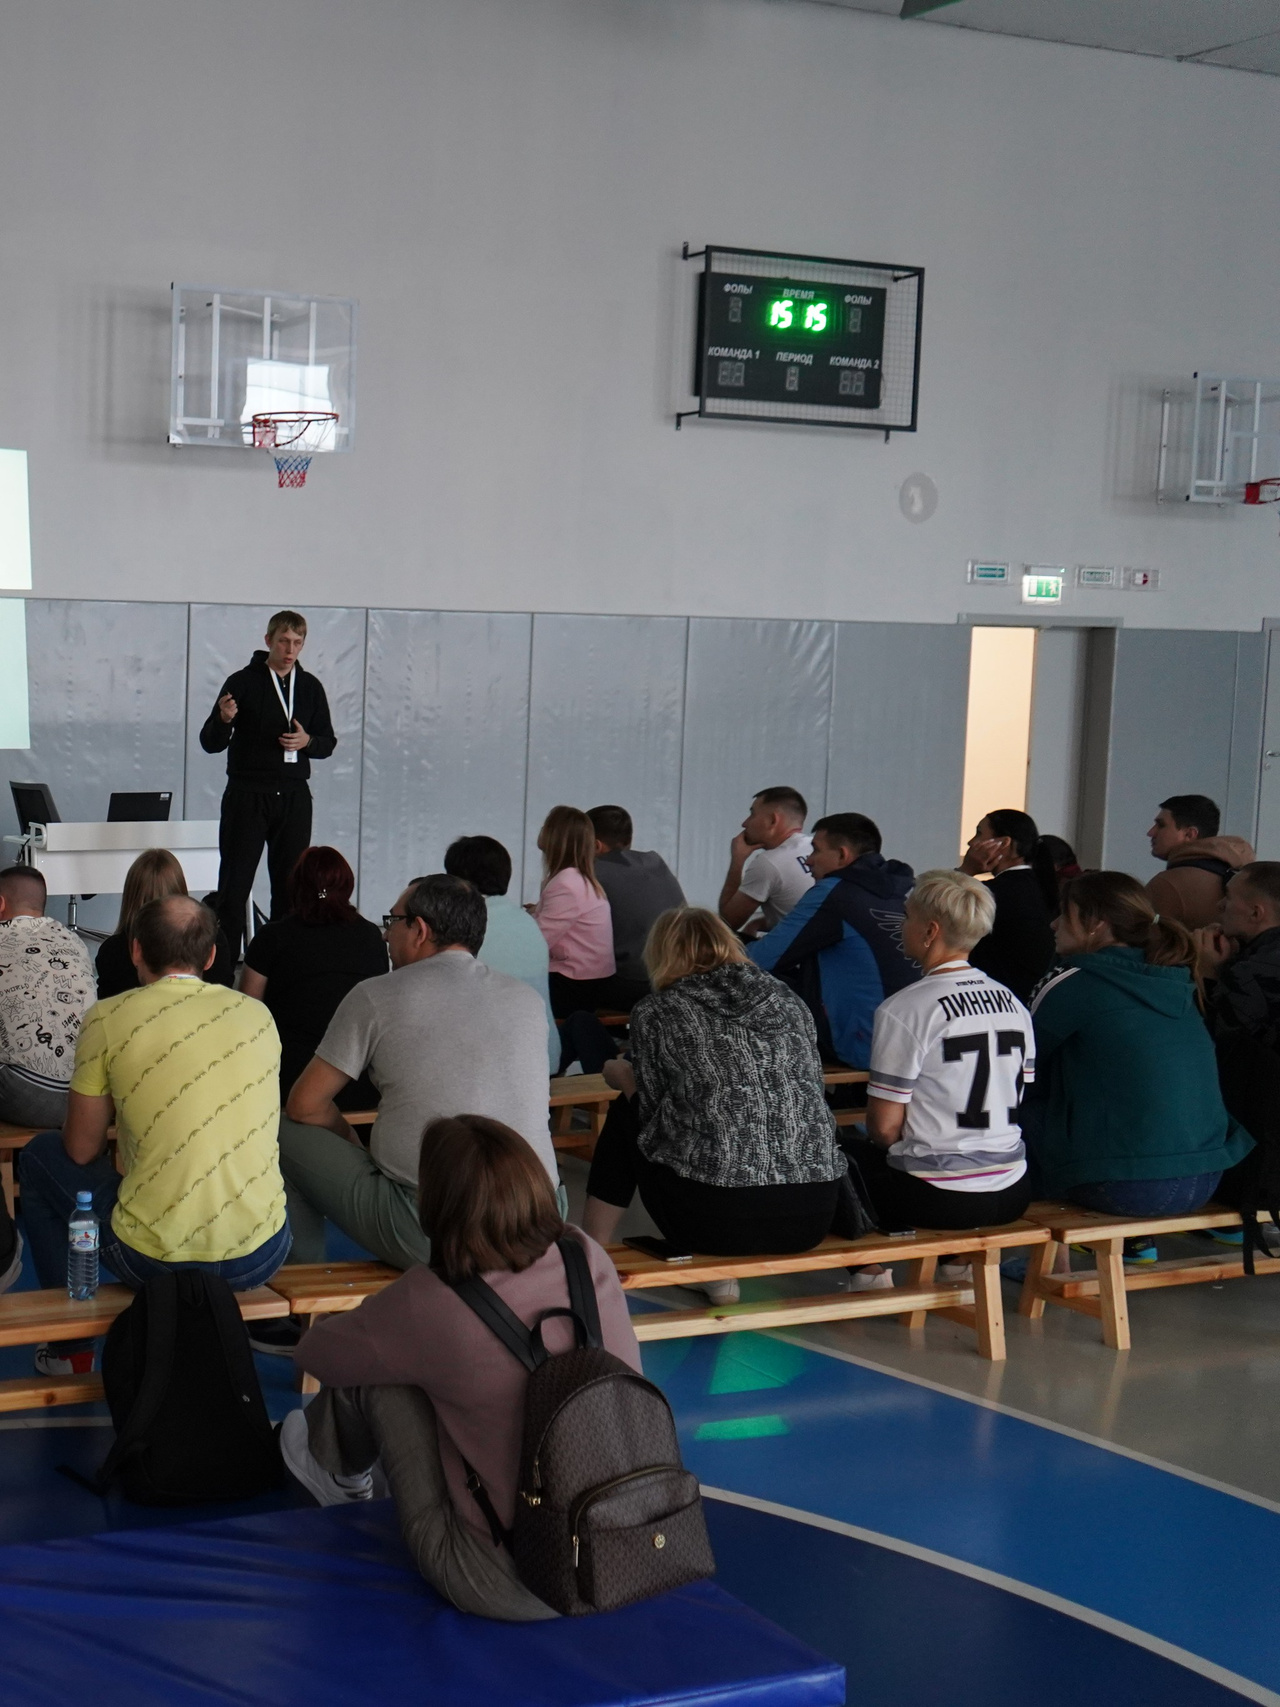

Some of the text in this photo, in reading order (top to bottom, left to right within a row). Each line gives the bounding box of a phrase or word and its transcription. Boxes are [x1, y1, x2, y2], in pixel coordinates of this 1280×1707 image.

[723, 283, 753, 295] ФОЛЫ
[782, 288, 815, 300] ВРЕМЯ
[844, 294, 872, 305] ФОЛЫ
[770, 300, 827, 331] 15 15
[708, 346, 754, 359] КОМАНДА
[776, 352, 813, 365] ПЕРИОД
[829, 356, 872, 369] КОМАНДА
[4, 983, 30, 994] WORLD
[937, 989, 1019, 1022] ЛИННИК
[942, 1029, 1026, 1130] 77
